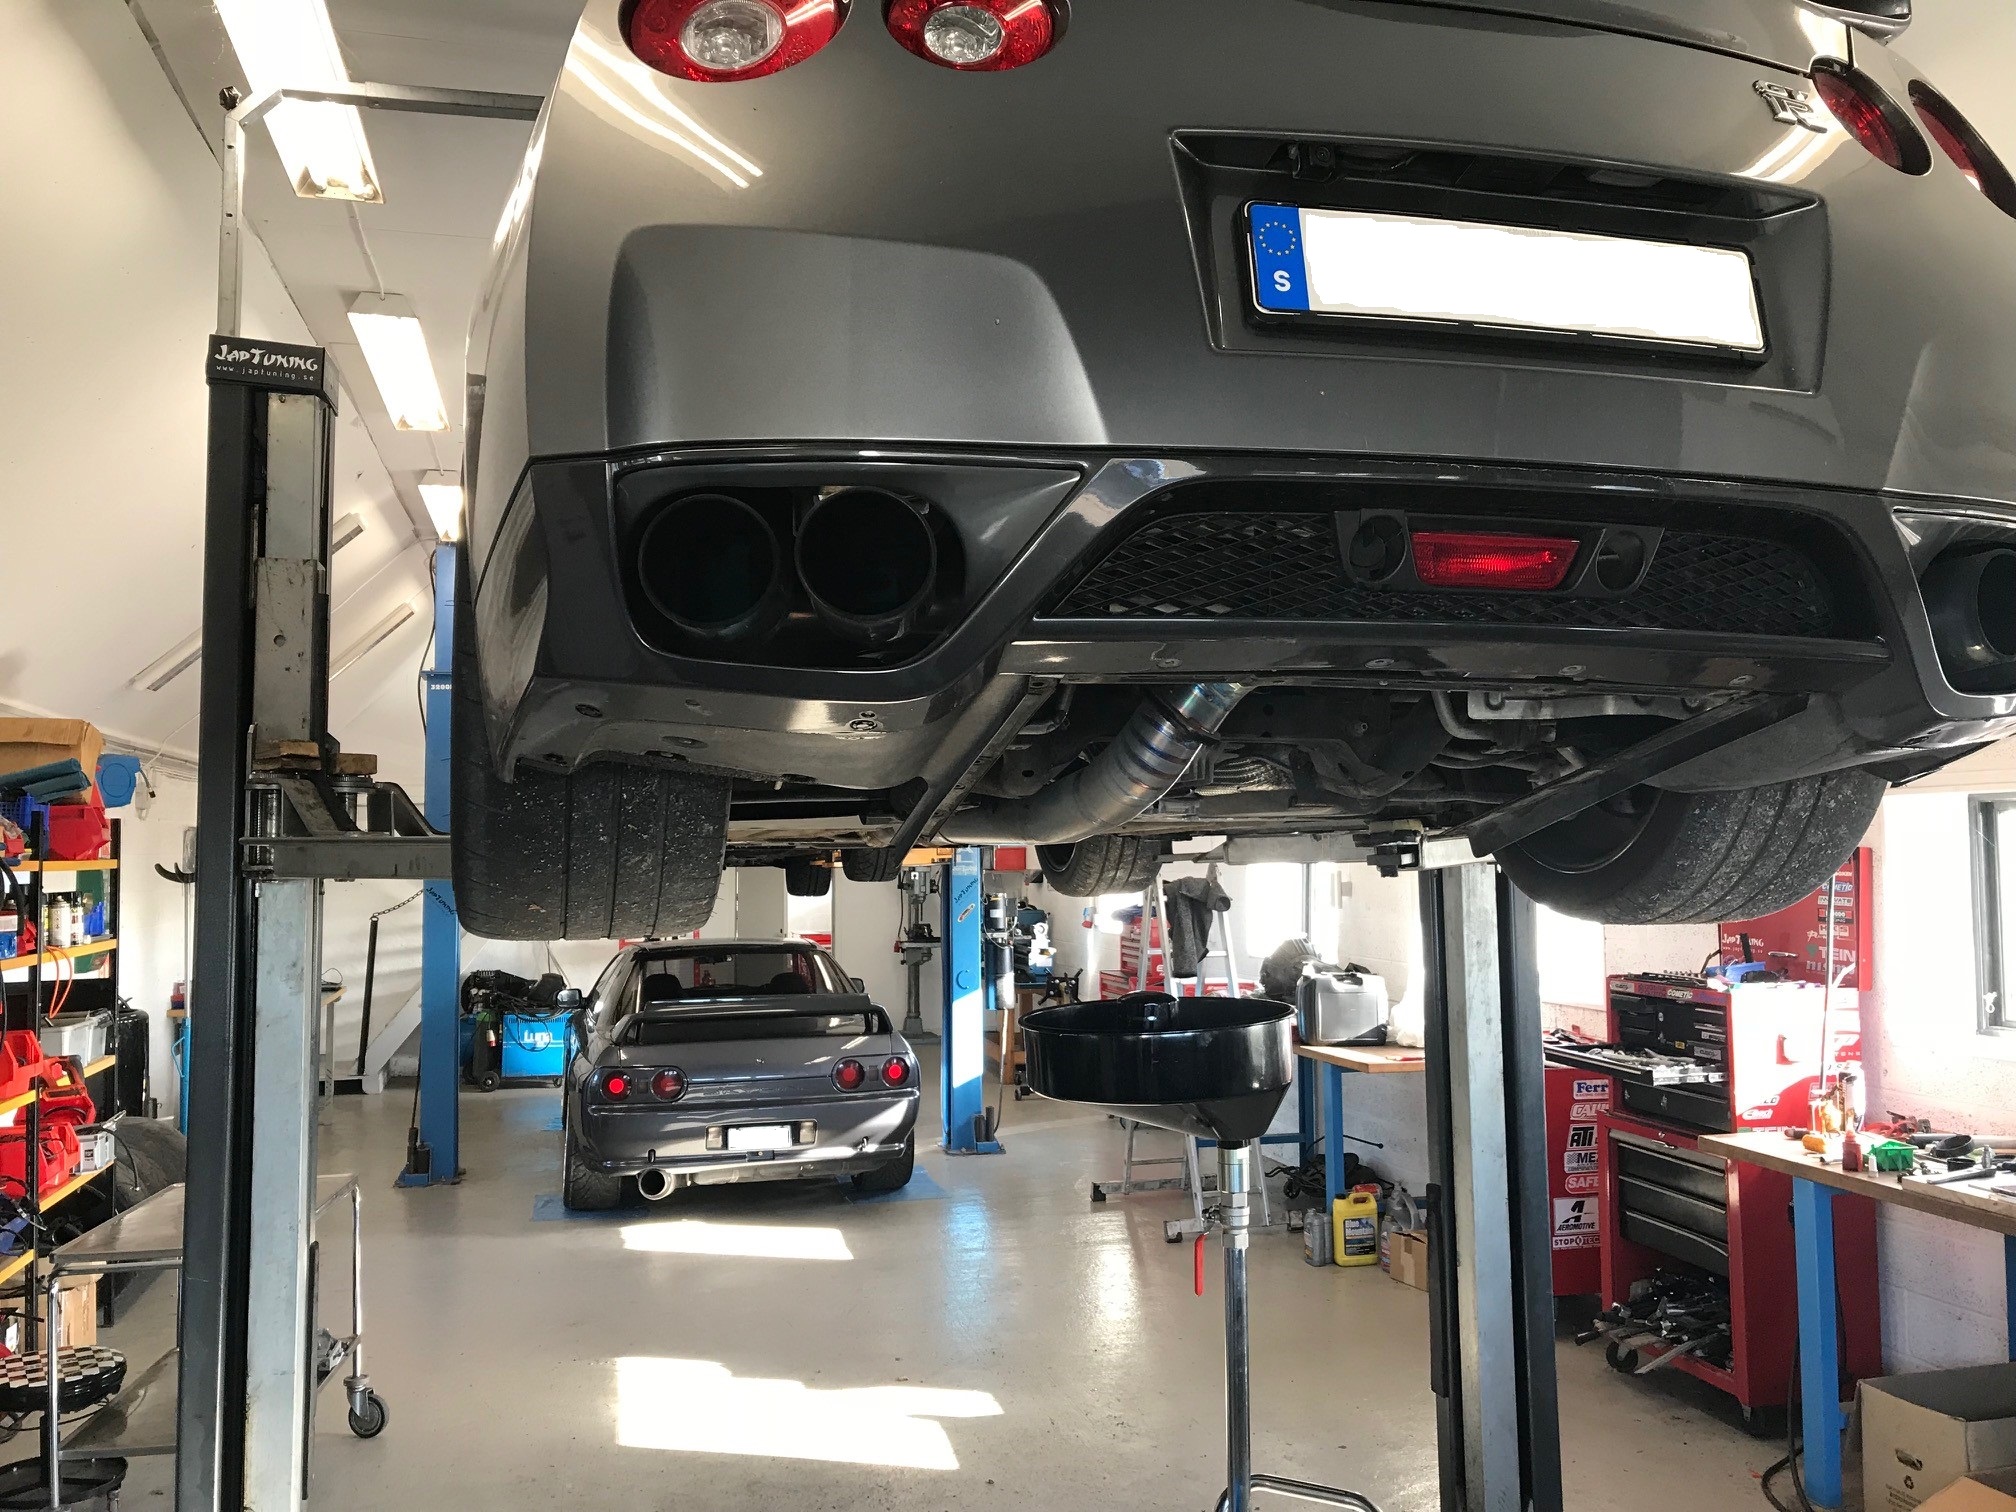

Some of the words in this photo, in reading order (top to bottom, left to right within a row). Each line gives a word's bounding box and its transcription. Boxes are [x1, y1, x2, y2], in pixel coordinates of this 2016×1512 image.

[1273, 270, 1291, 292] S
[216, 365, 315, 381] www.japtuning.se
[1667, 988, 1693, 999] COMETIC
[1556, 1221, 1596, 1232] AEROMOTIVE
